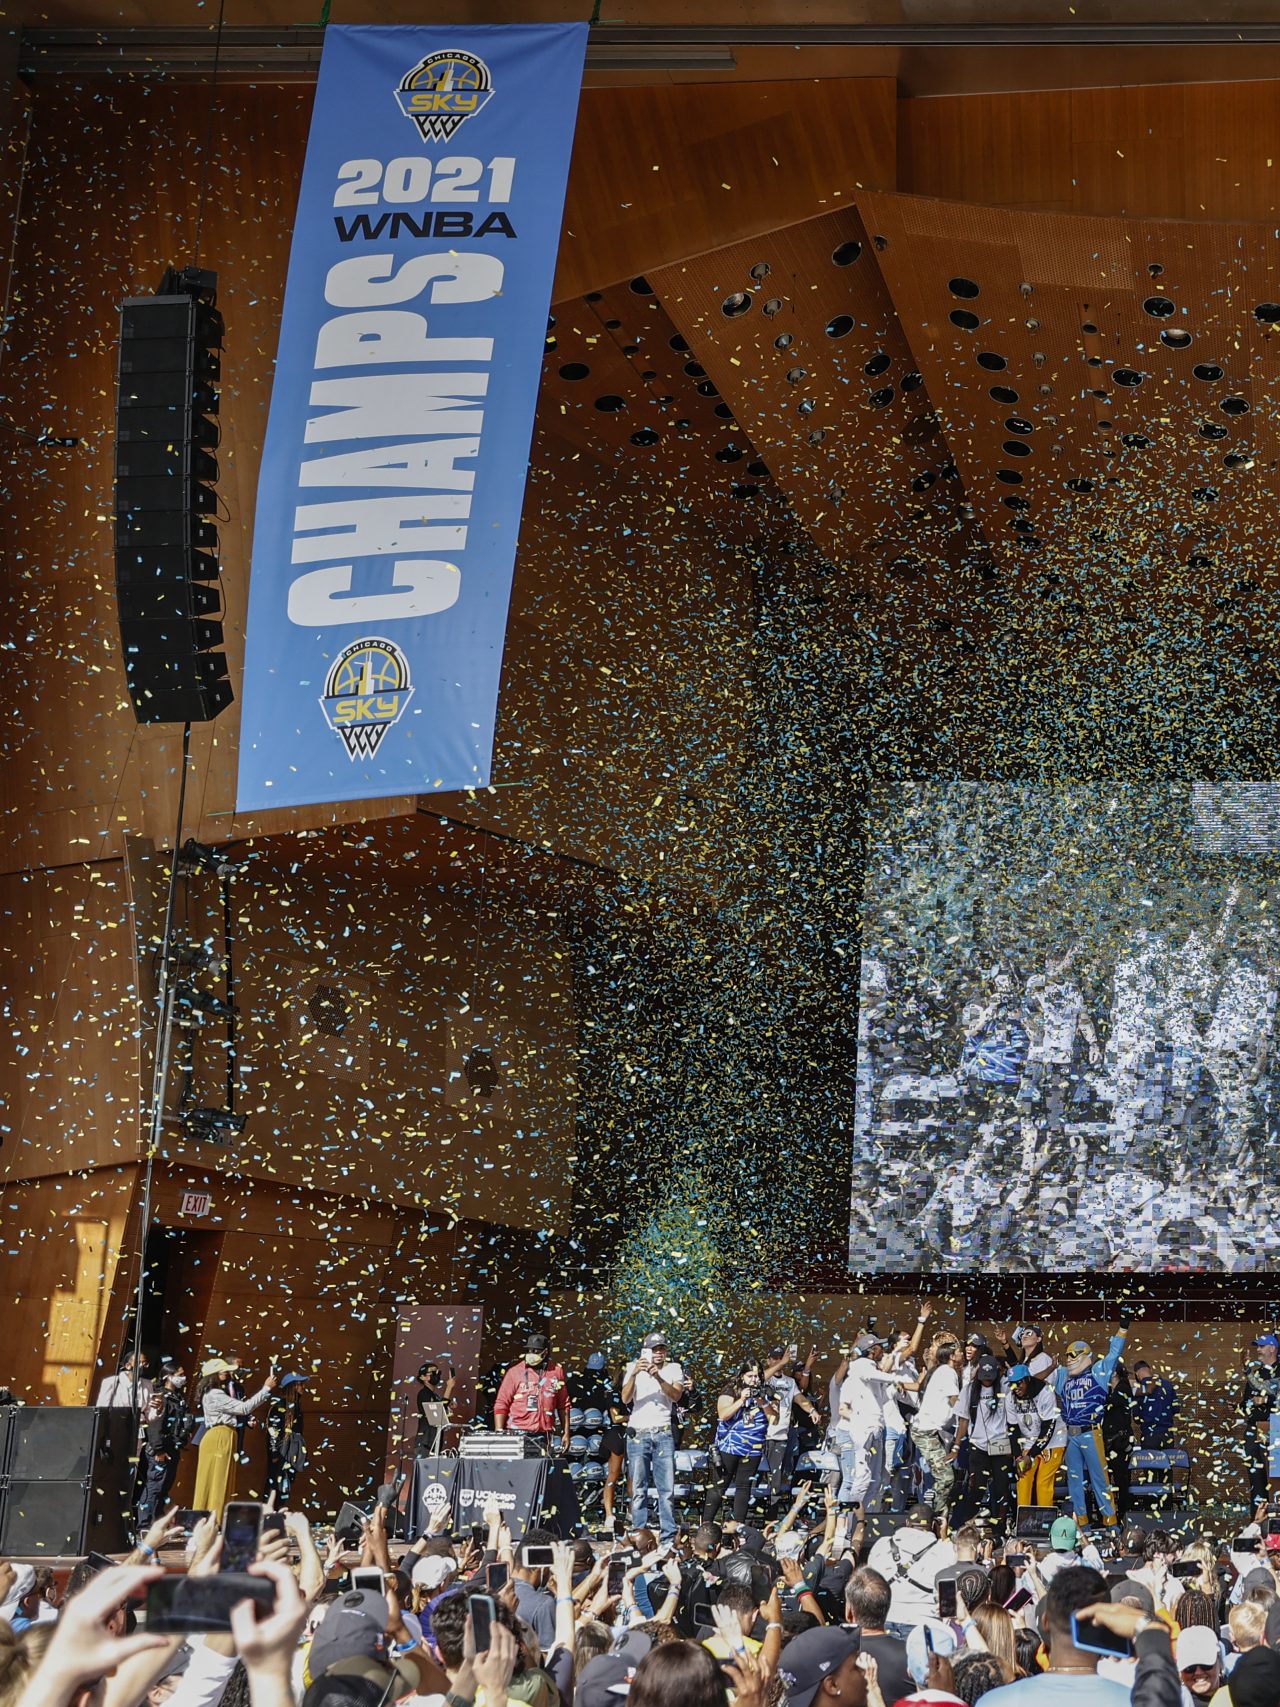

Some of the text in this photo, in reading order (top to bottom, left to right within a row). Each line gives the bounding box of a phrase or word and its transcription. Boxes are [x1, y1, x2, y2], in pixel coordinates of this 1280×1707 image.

[427, 53, 475, 64] CHICAGO
[407, 94, 478, 111] SKY
[333, 156, 516, 207] 2021
[333, 211, 517, 242] WNBA
[287, 252, 505, 627] CHAMPS
[345, 641, 393, 656] CHICAGO
[332, 695, 399, 723] SKY
[185, 1195, 208, 1212] EXIT
[475, 1490, 517, 1501] UChicago
